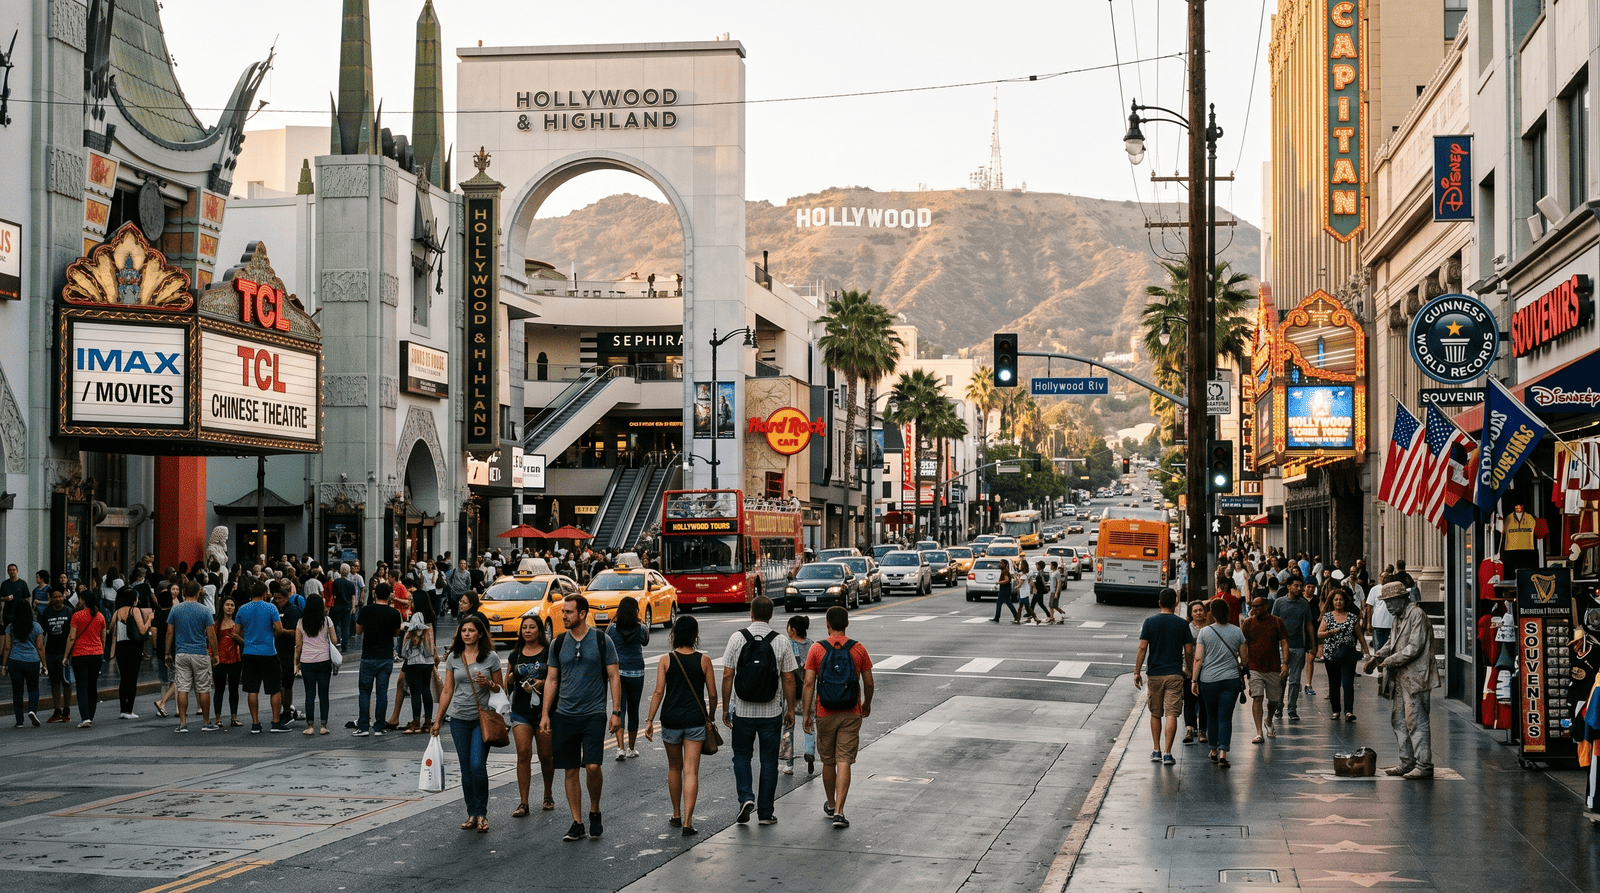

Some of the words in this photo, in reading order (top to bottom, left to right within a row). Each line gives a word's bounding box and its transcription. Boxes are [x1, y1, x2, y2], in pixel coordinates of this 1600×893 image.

[516, 88, 678, 108] HOLLYWOOD
[1330, 2, 1358, 215] CAPITAN
[516, 114, 531, 131] &
[543, 111, 678, 130] HIGHLAND
[796, 206, 932, 229] HOLLYWOOD
[472, 209, 489, 325] HOLLYWOOD
[234, 278, 291, 332] TCL
[1424, 300, 1486, 324] GUINNESS
[1511, 274, 1580, 359] SOUVENIRS
[474, 333, 486, 343] &
[613, 334, 684, 347] SEPHIRA
[77, 348, 181, 375] IMAX
[1417, 333, 1446, 374] WORLD
[1451, 332, 1493, 377] RECORDS
[237, 345, 286, 393] TCL
[96, 382, 173, 405] MOVIES
[473, 349, 487, 436] HIHLAND
[1035, 381, 1084, 393] Hollywood
[1422, 392, 1485, 403] SOUVENIR
[212, 393, 259, 423] CHINESE
[262, 401, 308, 429] THEATRE
[748, 417, 788, 434] Hard
[788, 417, 826, 437] Rock
[672, 523, 709, 531] HOLLYWOOD
[710, 522, 730, 530] TOURS
[1525, 622, 1541, 738] SOUVENIRS
